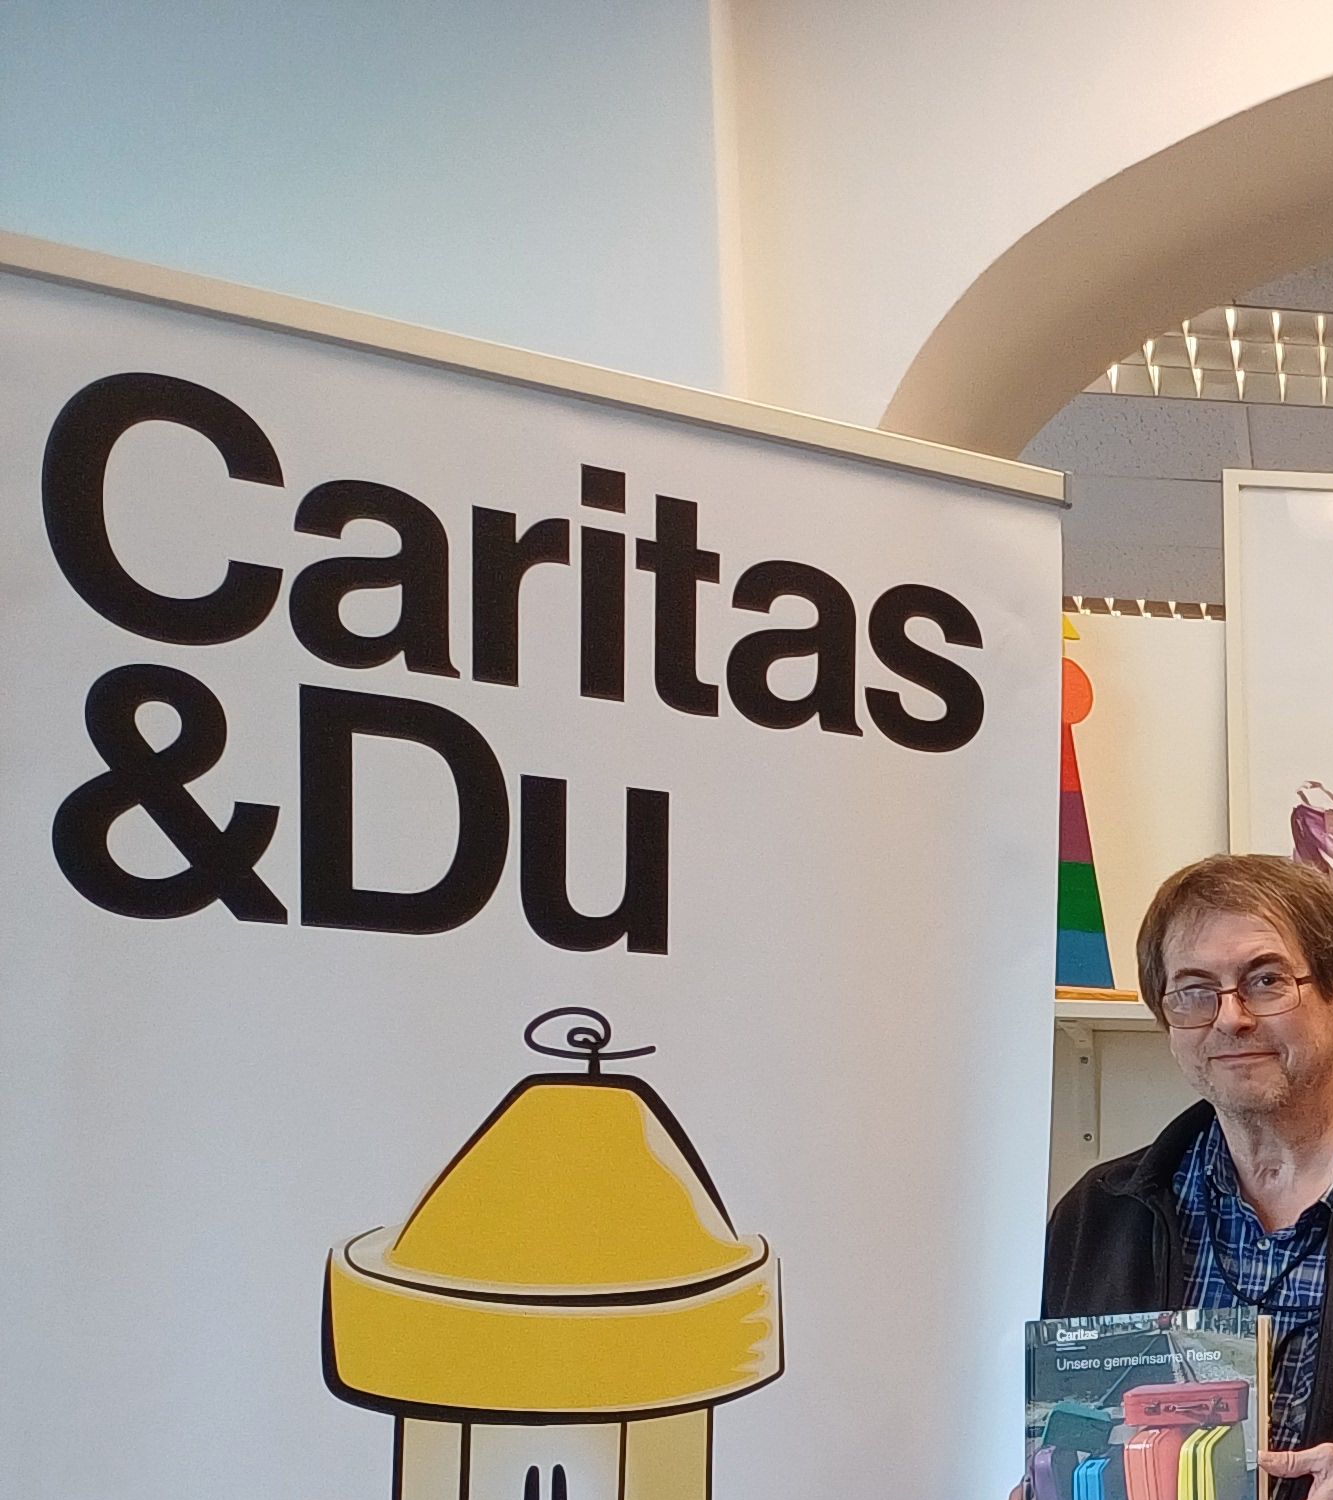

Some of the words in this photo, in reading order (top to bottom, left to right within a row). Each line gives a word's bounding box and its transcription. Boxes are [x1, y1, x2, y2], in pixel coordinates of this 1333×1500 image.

[42, 372, 985, 754] Caritas
[51, 663, 671, 956] &Du
[1056, 1328, 1098, 1342] Caritas
